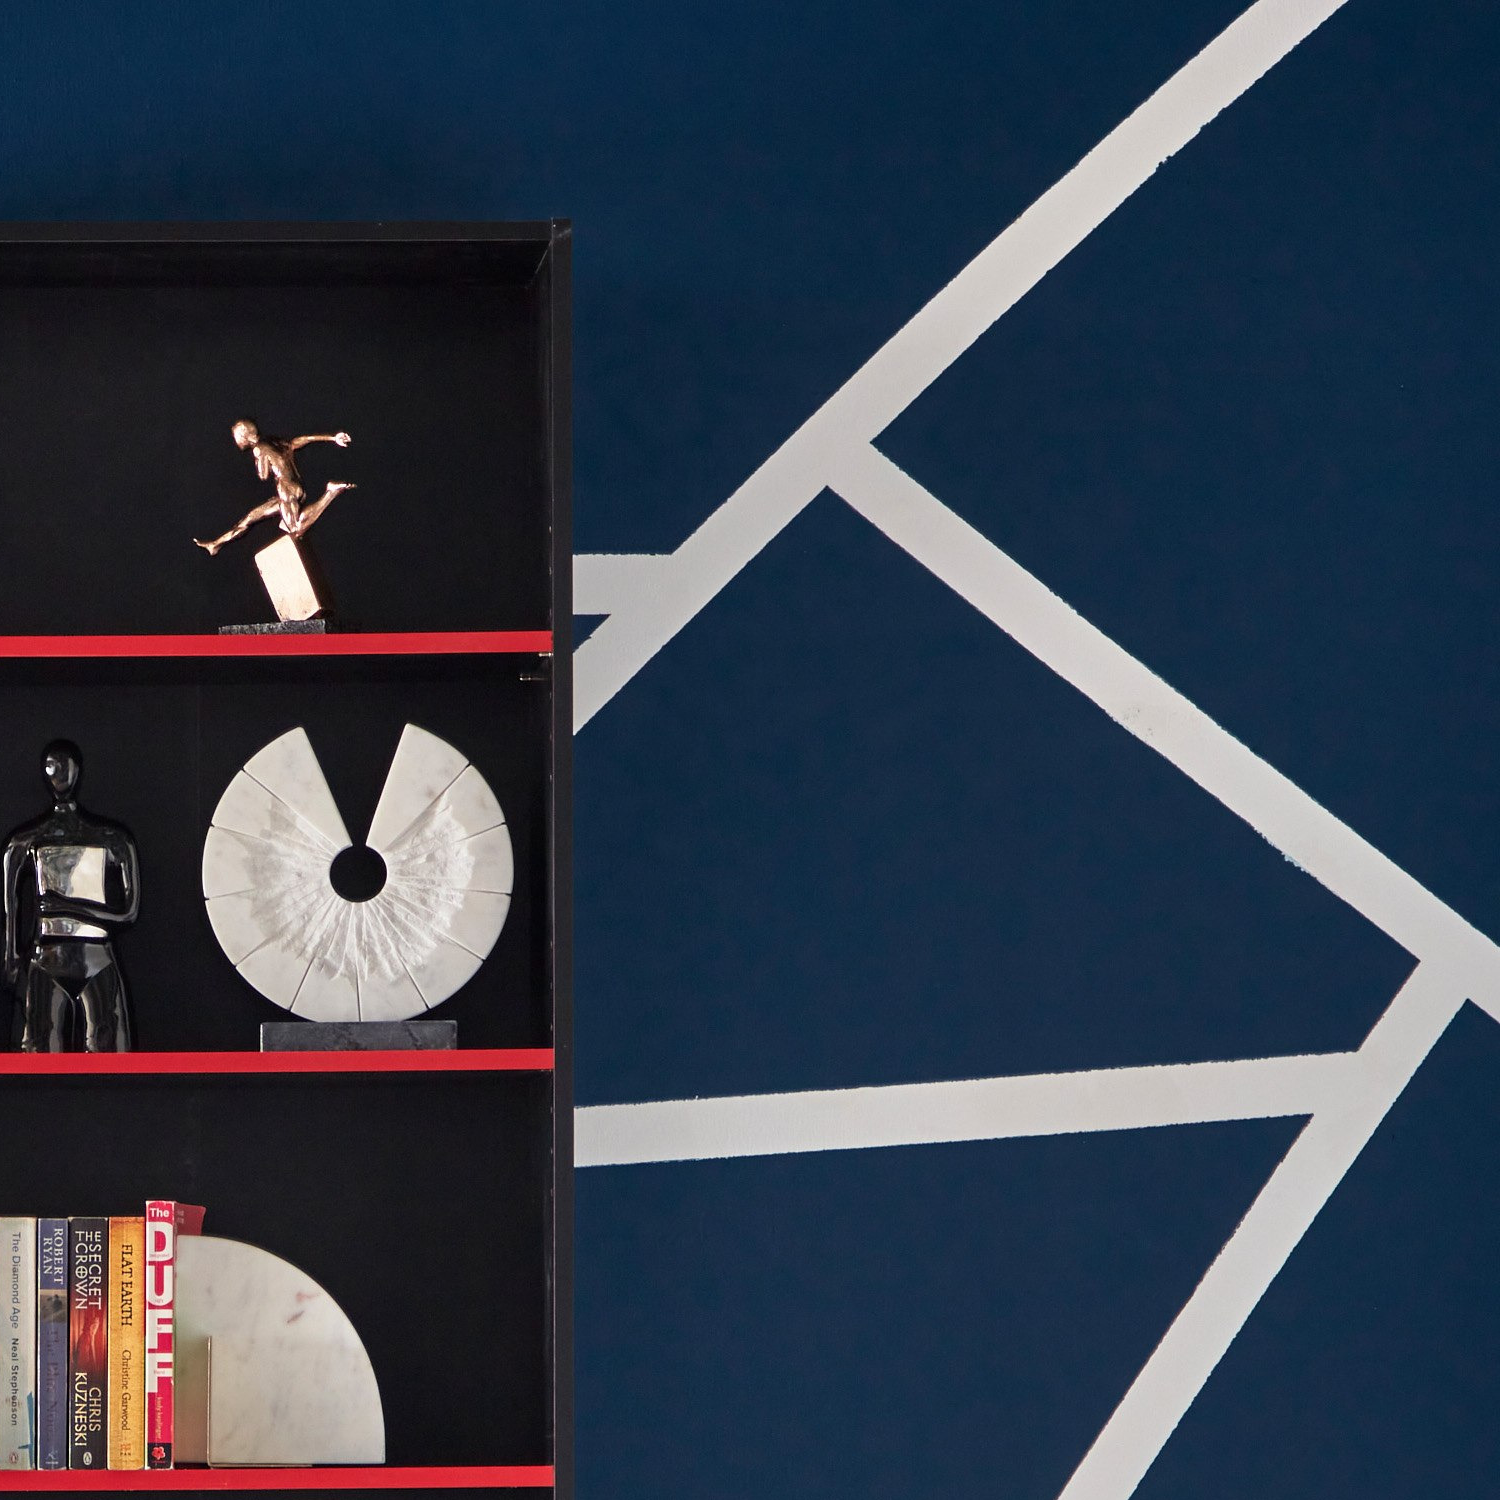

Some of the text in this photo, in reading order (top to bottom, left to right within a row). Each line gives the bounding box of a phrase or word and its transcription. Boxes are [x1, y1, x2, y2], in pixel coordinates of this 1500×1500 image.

[74, 1230, 101, 1242] THE
[150, 1208, 170, 1218] The
[9, 1232, 21, 1329] The Diamond Age
[43, 1237, 53, 1275] RYAN
[53, 1228, 64, 1285] ROBERT
[74, 1242, 88, 1310] CROWN
[88, 1243, 102, 1310] SECRET
[121, 1243, 133, 1327] FLAT EARTH
[147, 1221, 174, 1393] DUFF
[9, 1338, 19, 1426] Neal Stephenson
[74, 1372, 88, 1447] KUZNESKI
[88, 1386, 102, 1432] CHRIS
[121, 1349, 132, 1431] Christine Garwood
